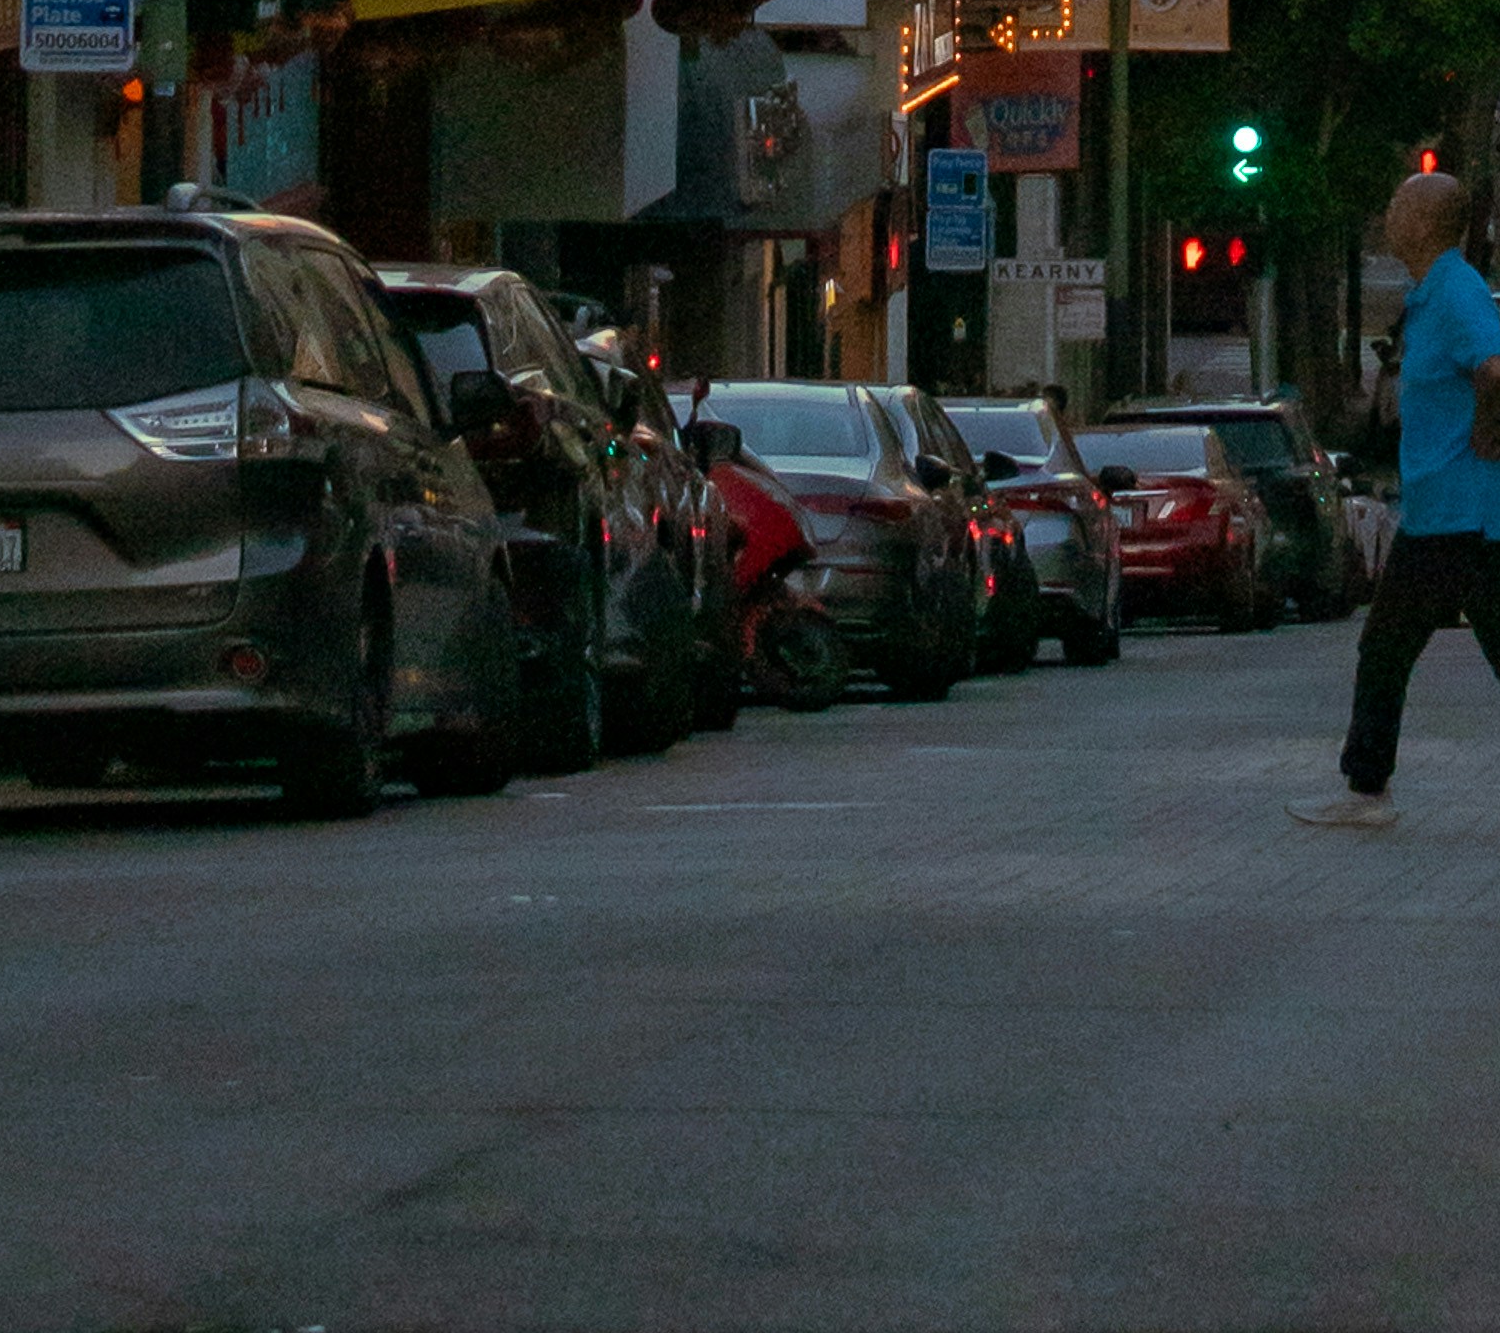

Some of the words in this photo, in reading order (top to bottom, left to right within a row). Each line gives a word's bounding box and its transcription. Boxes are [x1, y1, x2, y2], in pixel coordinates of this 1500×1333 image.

[32, 5, 82, 23] Plate
[992, 96, 1070, 125] Quickly
[997, 263, 1098, 280] KEARNY
